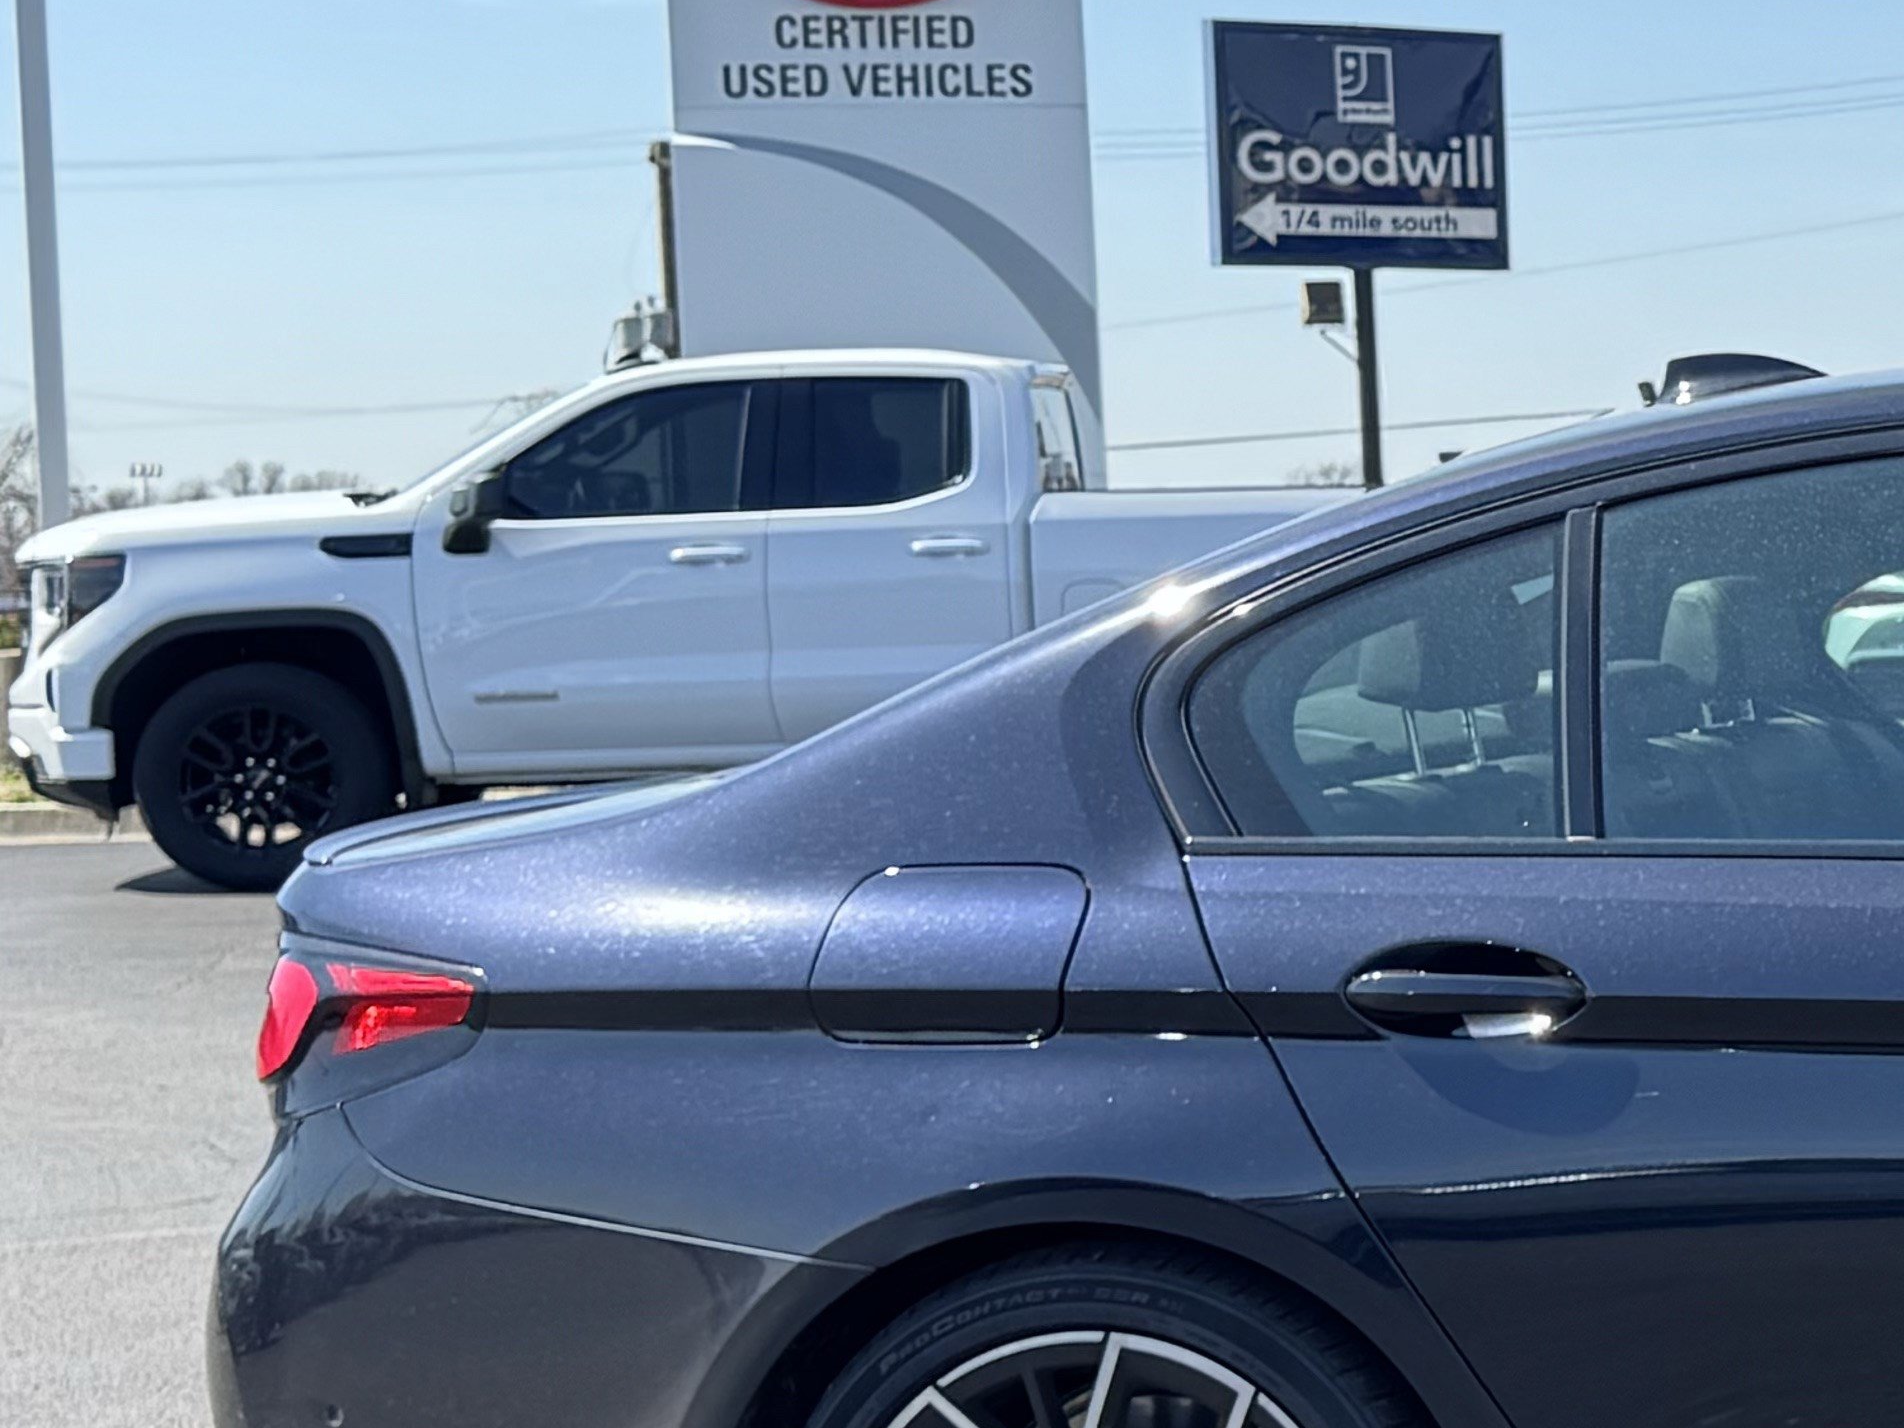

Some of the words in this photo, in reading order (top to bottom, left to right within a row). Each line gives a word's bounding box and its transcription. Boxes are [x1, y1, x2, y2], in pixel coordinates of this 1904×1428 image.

[774, 15, 975, 50] CERTIFIED
[722, 64, 829, 99] USED
[843, 63, 1033, 99] VEHICLES
[1236, 129, 1495, 190] Goodwill
[1281, 209, 1320, 230] 1/4
[1330, 209, 1383, 230] mile
[1391, 210, 1458, 232] south
